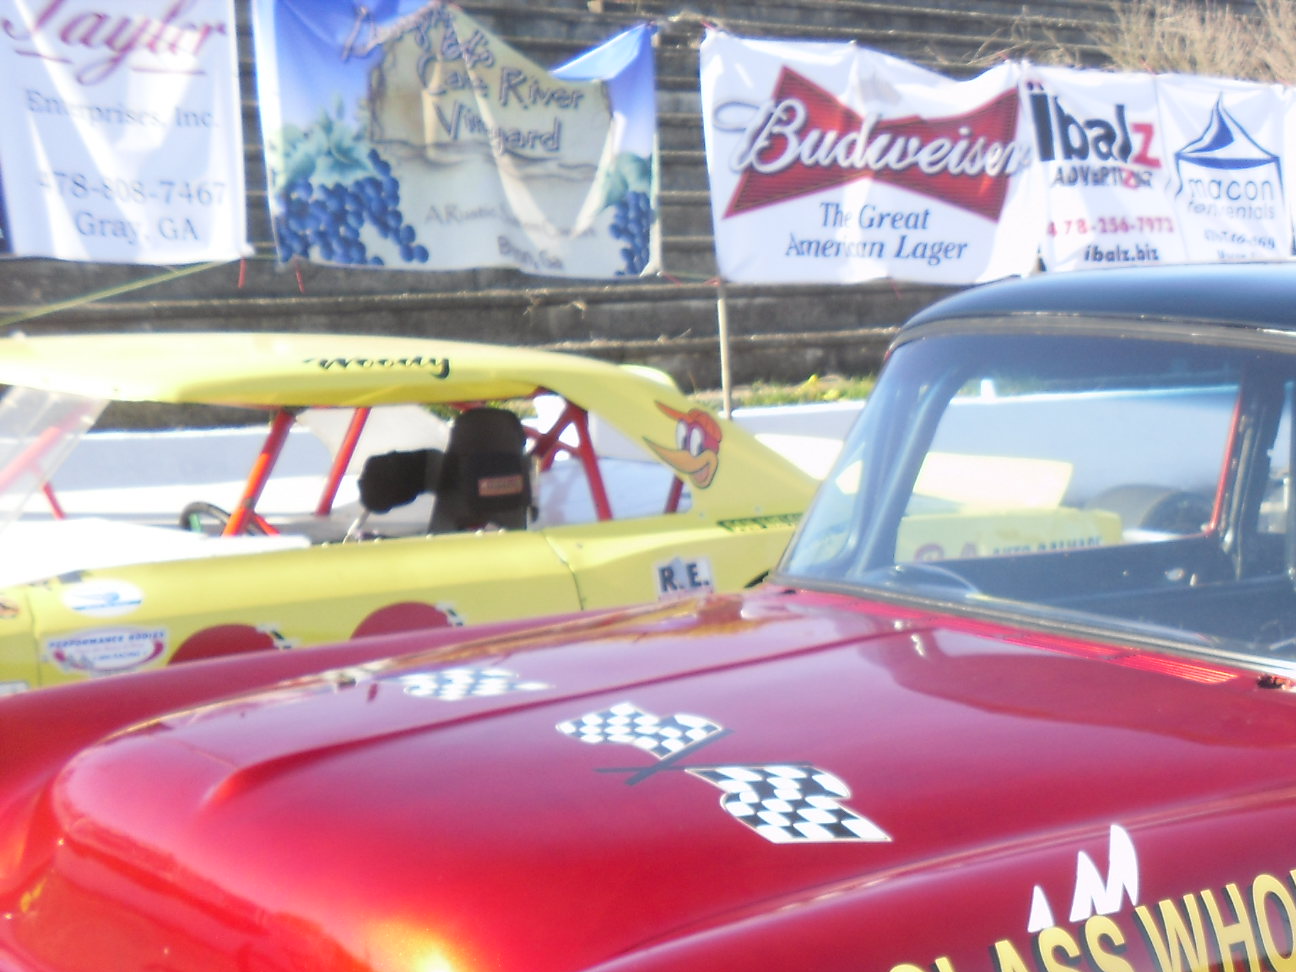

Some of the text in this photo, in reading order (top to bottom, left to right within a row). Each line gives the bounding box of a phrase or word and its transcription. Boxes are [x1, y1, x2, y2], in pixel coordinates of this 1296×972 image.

[500, 66, 584, 109] River
[714, 98, 1031, 176] Budweiser
[1188, 178, 1275, 201] macon
[158, 217, 200, 242] GA
[820, 202, 931, 230] The Great
[785, 231, 968, 266] American Lager
